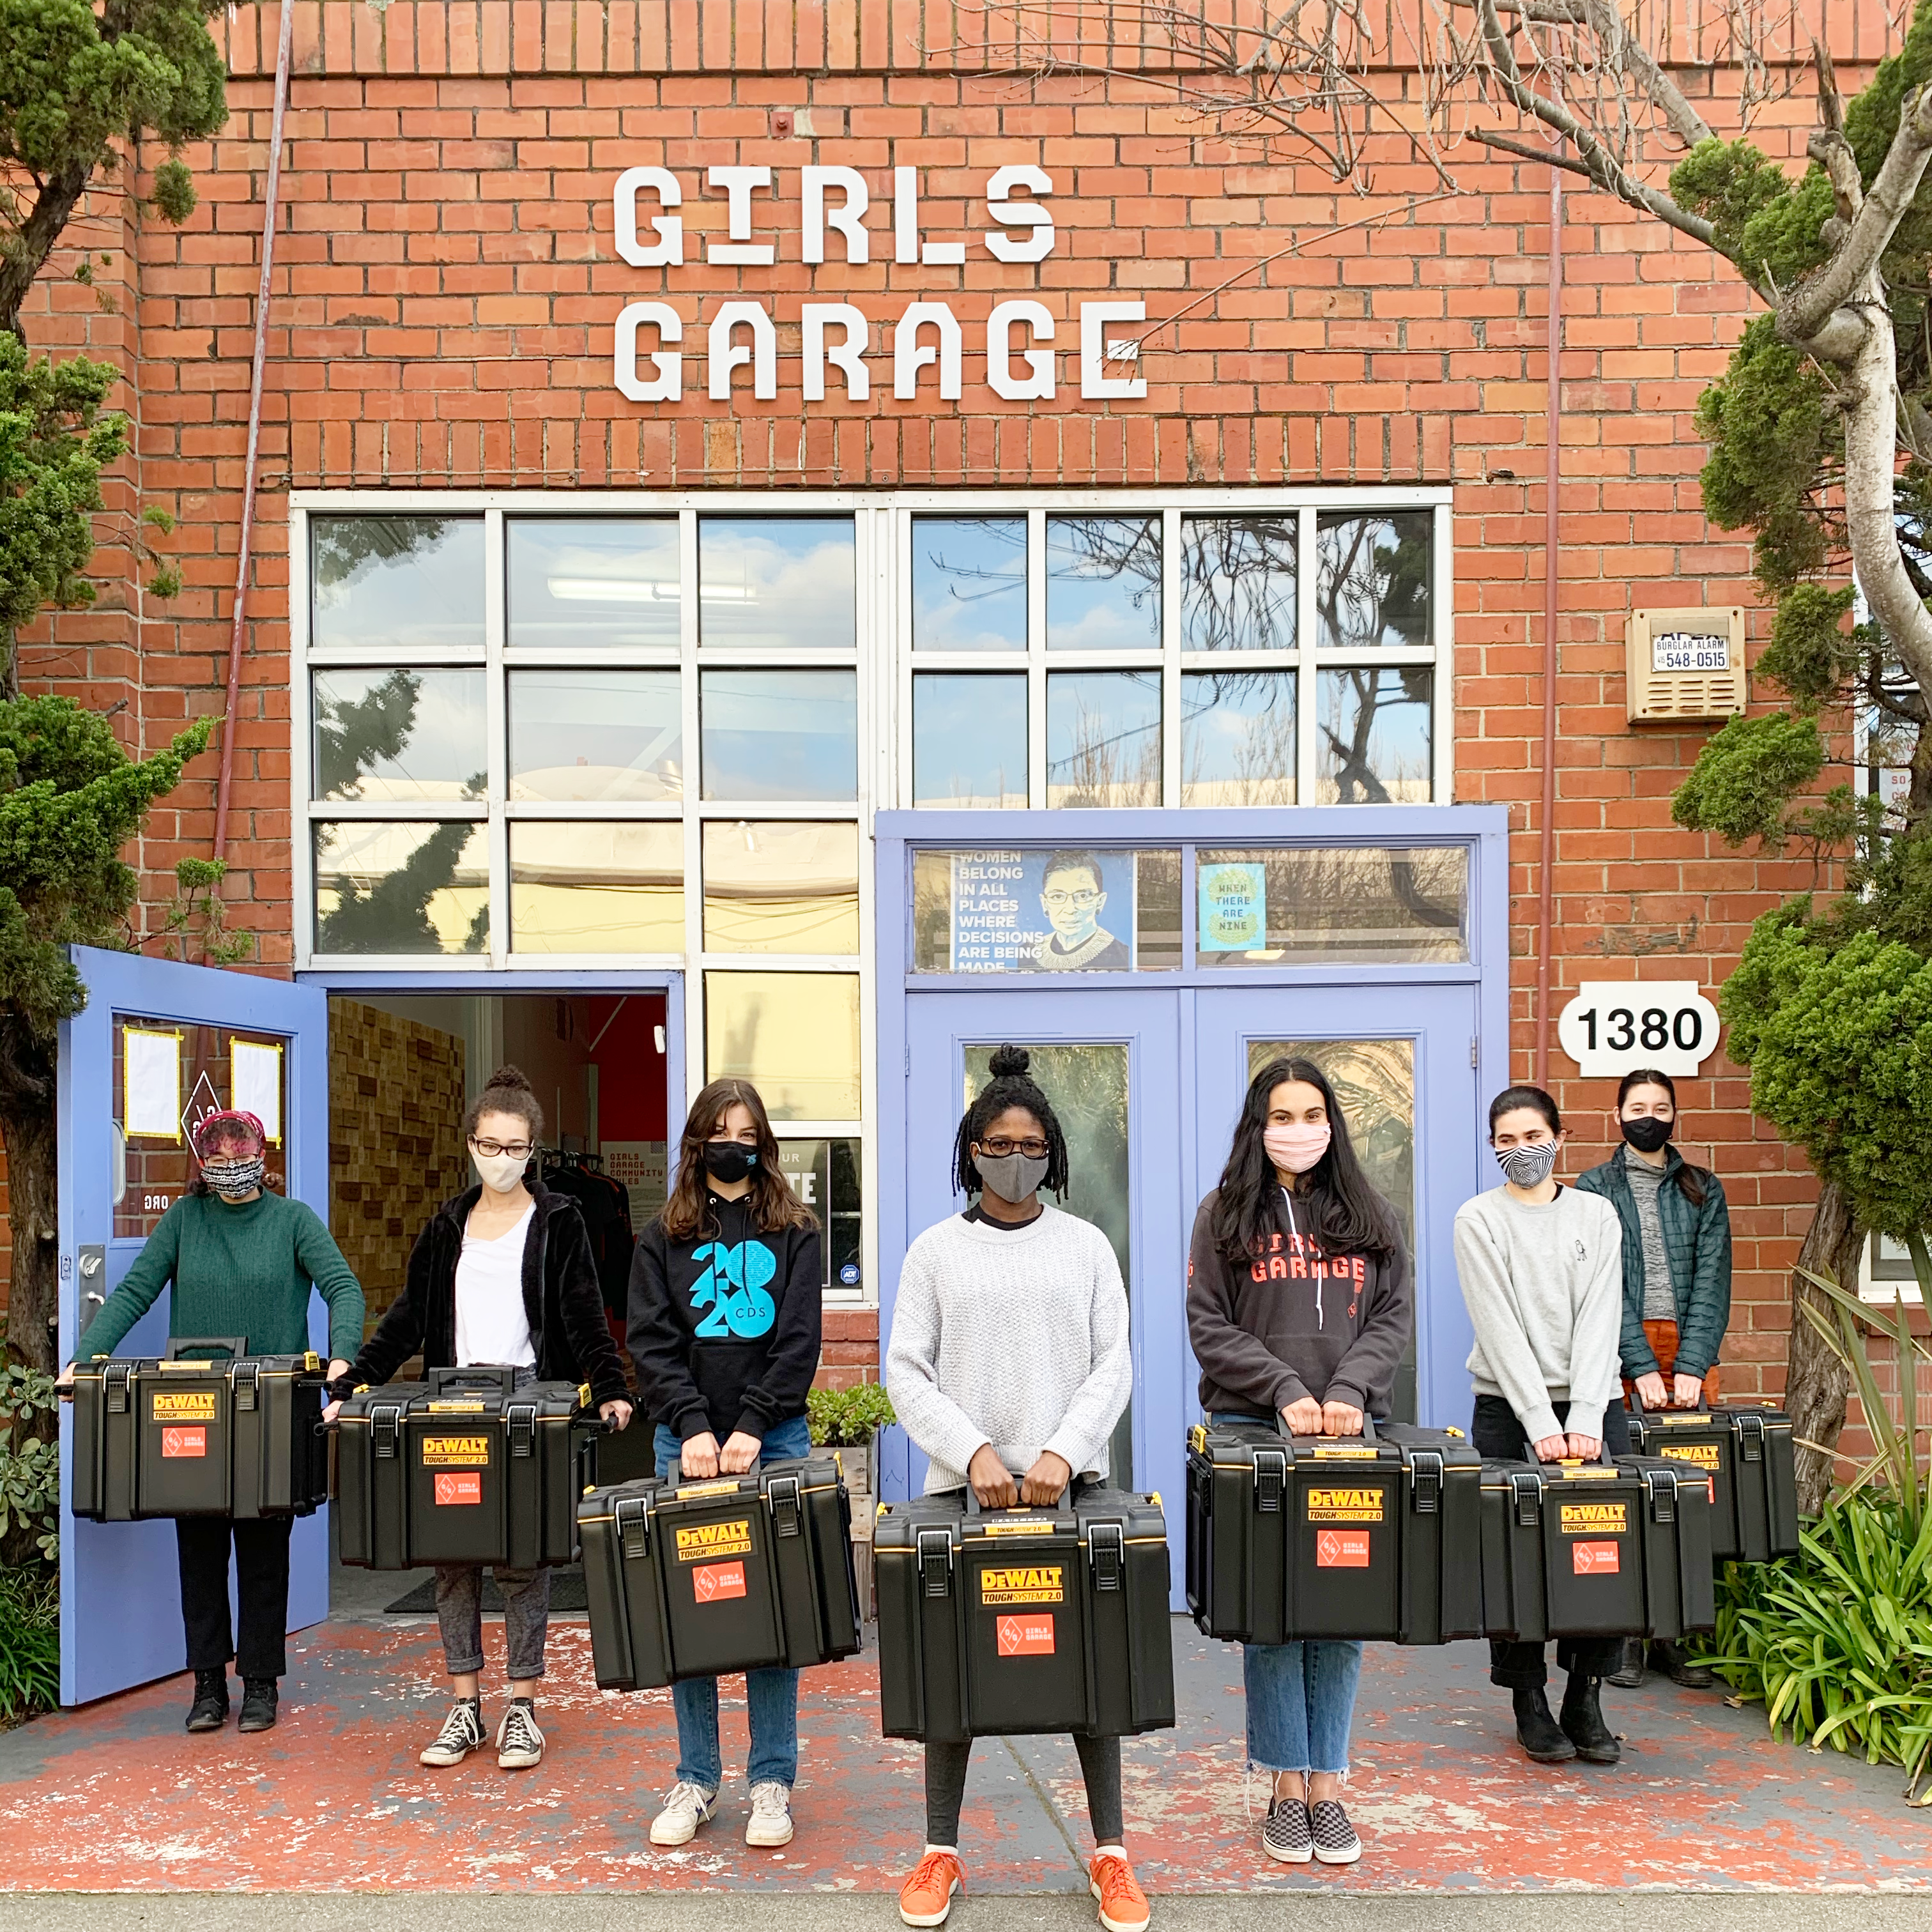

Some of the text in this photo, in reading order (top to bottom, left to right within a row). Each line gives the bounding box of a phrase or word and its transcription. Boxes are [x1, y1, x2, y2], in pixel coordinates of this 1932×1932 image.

[614, 165, 1054, 266] GIRLS
[614, 300, 1147, 401] GARAGE
[1657, 640, 1724, 650] BURGLAR ALARM
[1666, 652, 1725, 667] 548-0515
[960, 851, 1022, 863] WOMEN
[959, 867, 1023, 879] BELONG
[959, 884, 1008, 896] IN ALL
[1219, 884, 1247, 893] WHEN
[959, 900, 1019, 912] PLACES
[1216, 896, 1250, 905] THERE
[1223, 909, 1243, 917] ARE
[958, 916, 1016, 928] WHERE
[1220, 922, 1247, 930] NINE
[959, 931, 1044, 943] DECISIONS
[958, 947, 1043, 958] ARE BEING
[1578, 1008, 1702, 1050] 1380
[1251, 1256, 1365, 1282] GARAGE
[735, 1307, 765, 1317] CDS
[1048, 1591, 1061, 1600] 2.0
